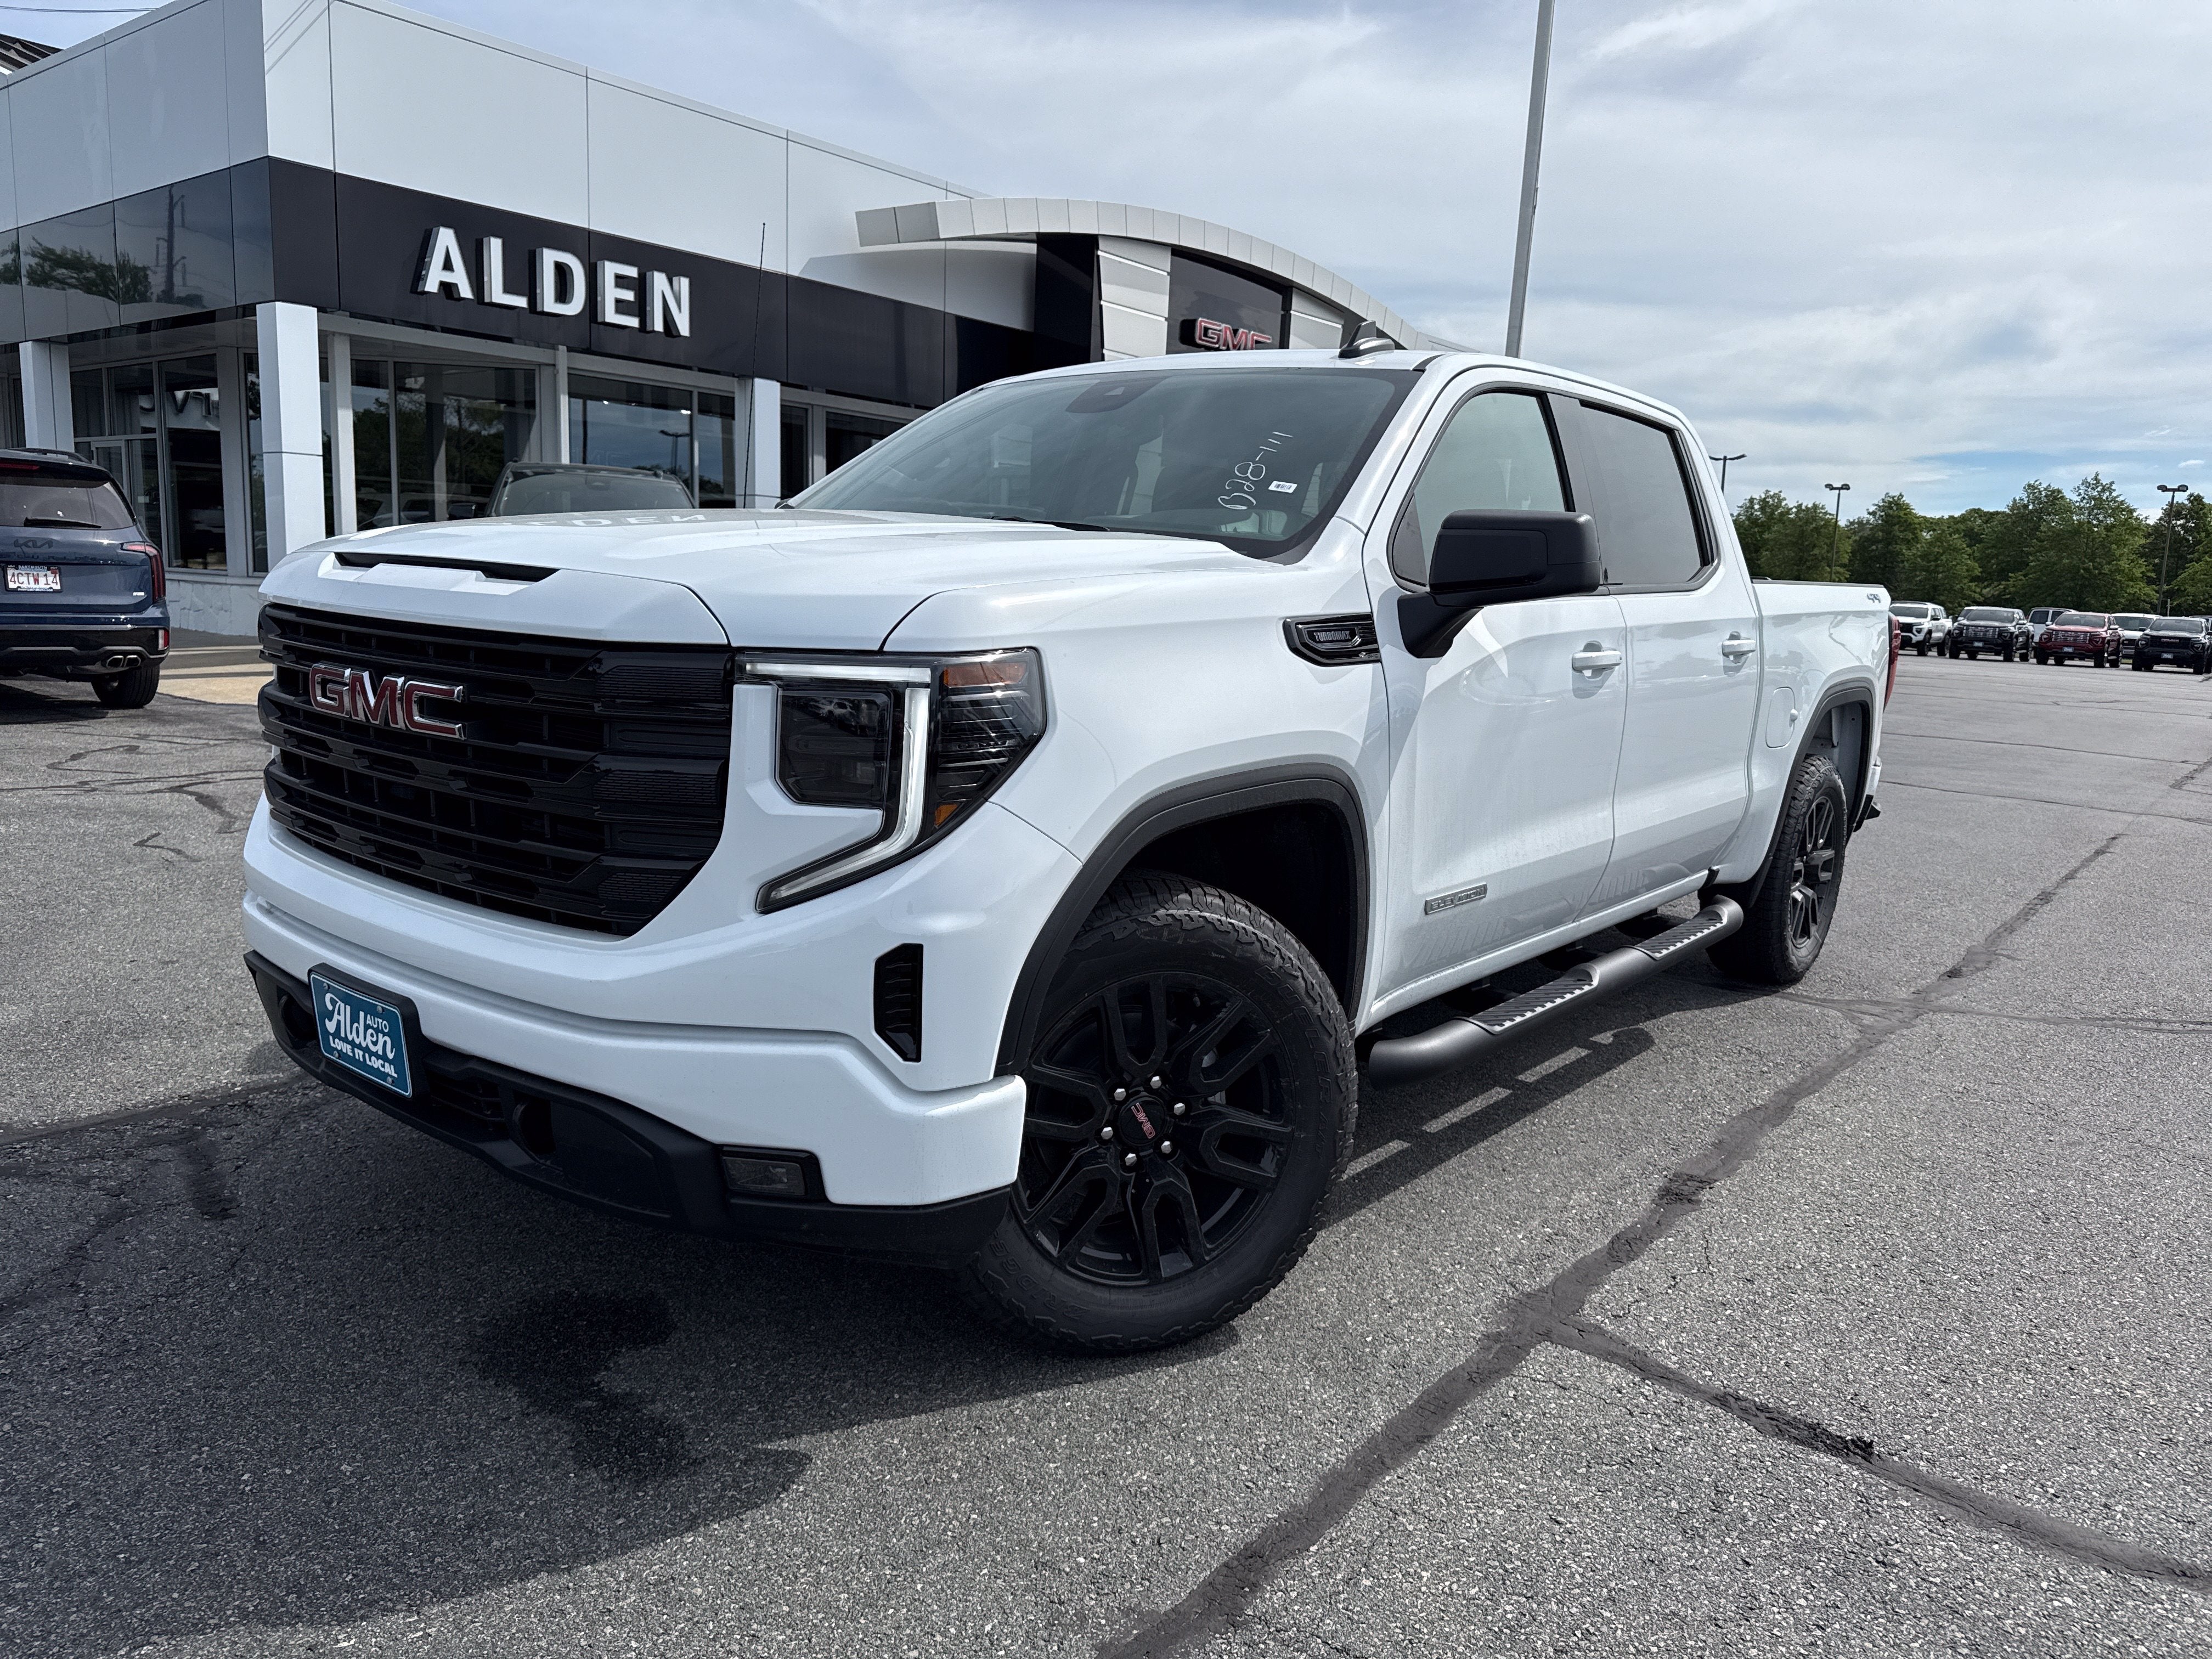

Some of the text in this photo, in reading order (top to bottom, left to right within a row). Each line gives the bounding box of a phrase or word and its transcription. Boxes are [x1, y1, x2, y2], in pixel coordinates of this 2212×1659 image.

[419, 225, 690, 337] ALDEN
[9, 572, 58, 585] 4CTW 14
[1314, 631, 1351, 641] TURBOMAX
[309, 663, 464, 740] GMC
[325, 992, 396, 1059] Alden
[366, 1014, 389, 1032] AUTO
[329, 1035, 398, 1078] LOVE IT LOCAL
[1131, 1102, 1155, 1139] GMC
